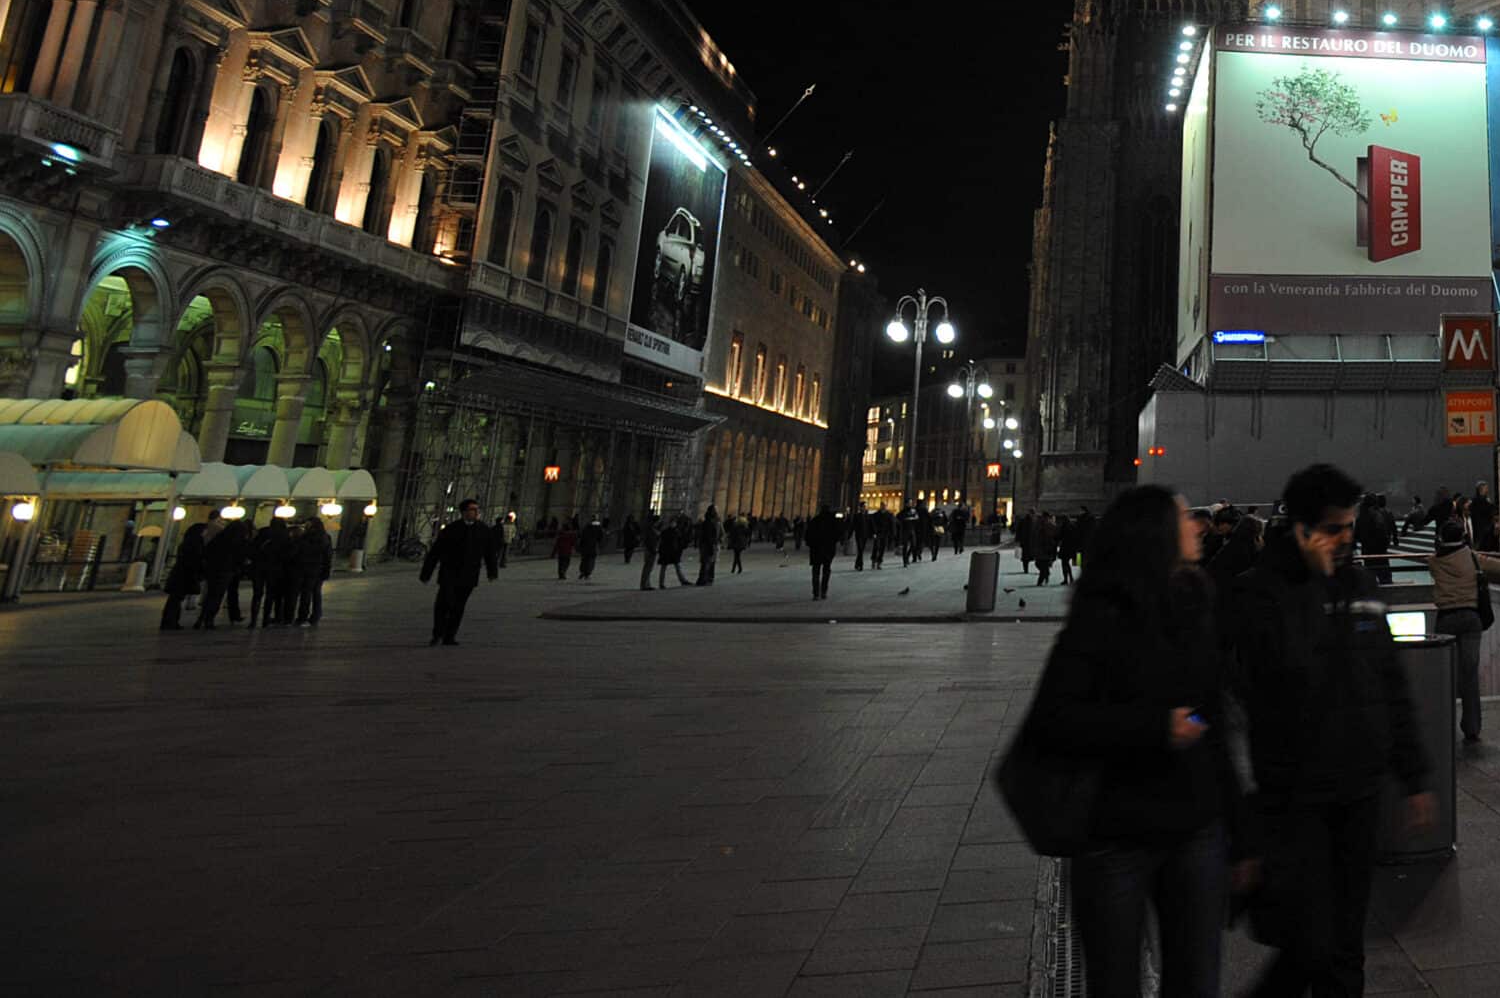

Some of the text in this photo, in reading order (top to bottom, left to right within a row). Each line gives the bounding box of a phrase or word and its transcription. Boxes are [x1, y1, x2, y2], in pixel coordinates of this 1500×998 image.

[1225, 33, 1478, 58] PER IL RESTAURO DEL DUOMO
[1390, 159, 1409, 247] CAMPER
[1224, 282, 1478, 298] con la Veneranda Fabbrica del Duomo
[1447, 329, 1488, 360] M
